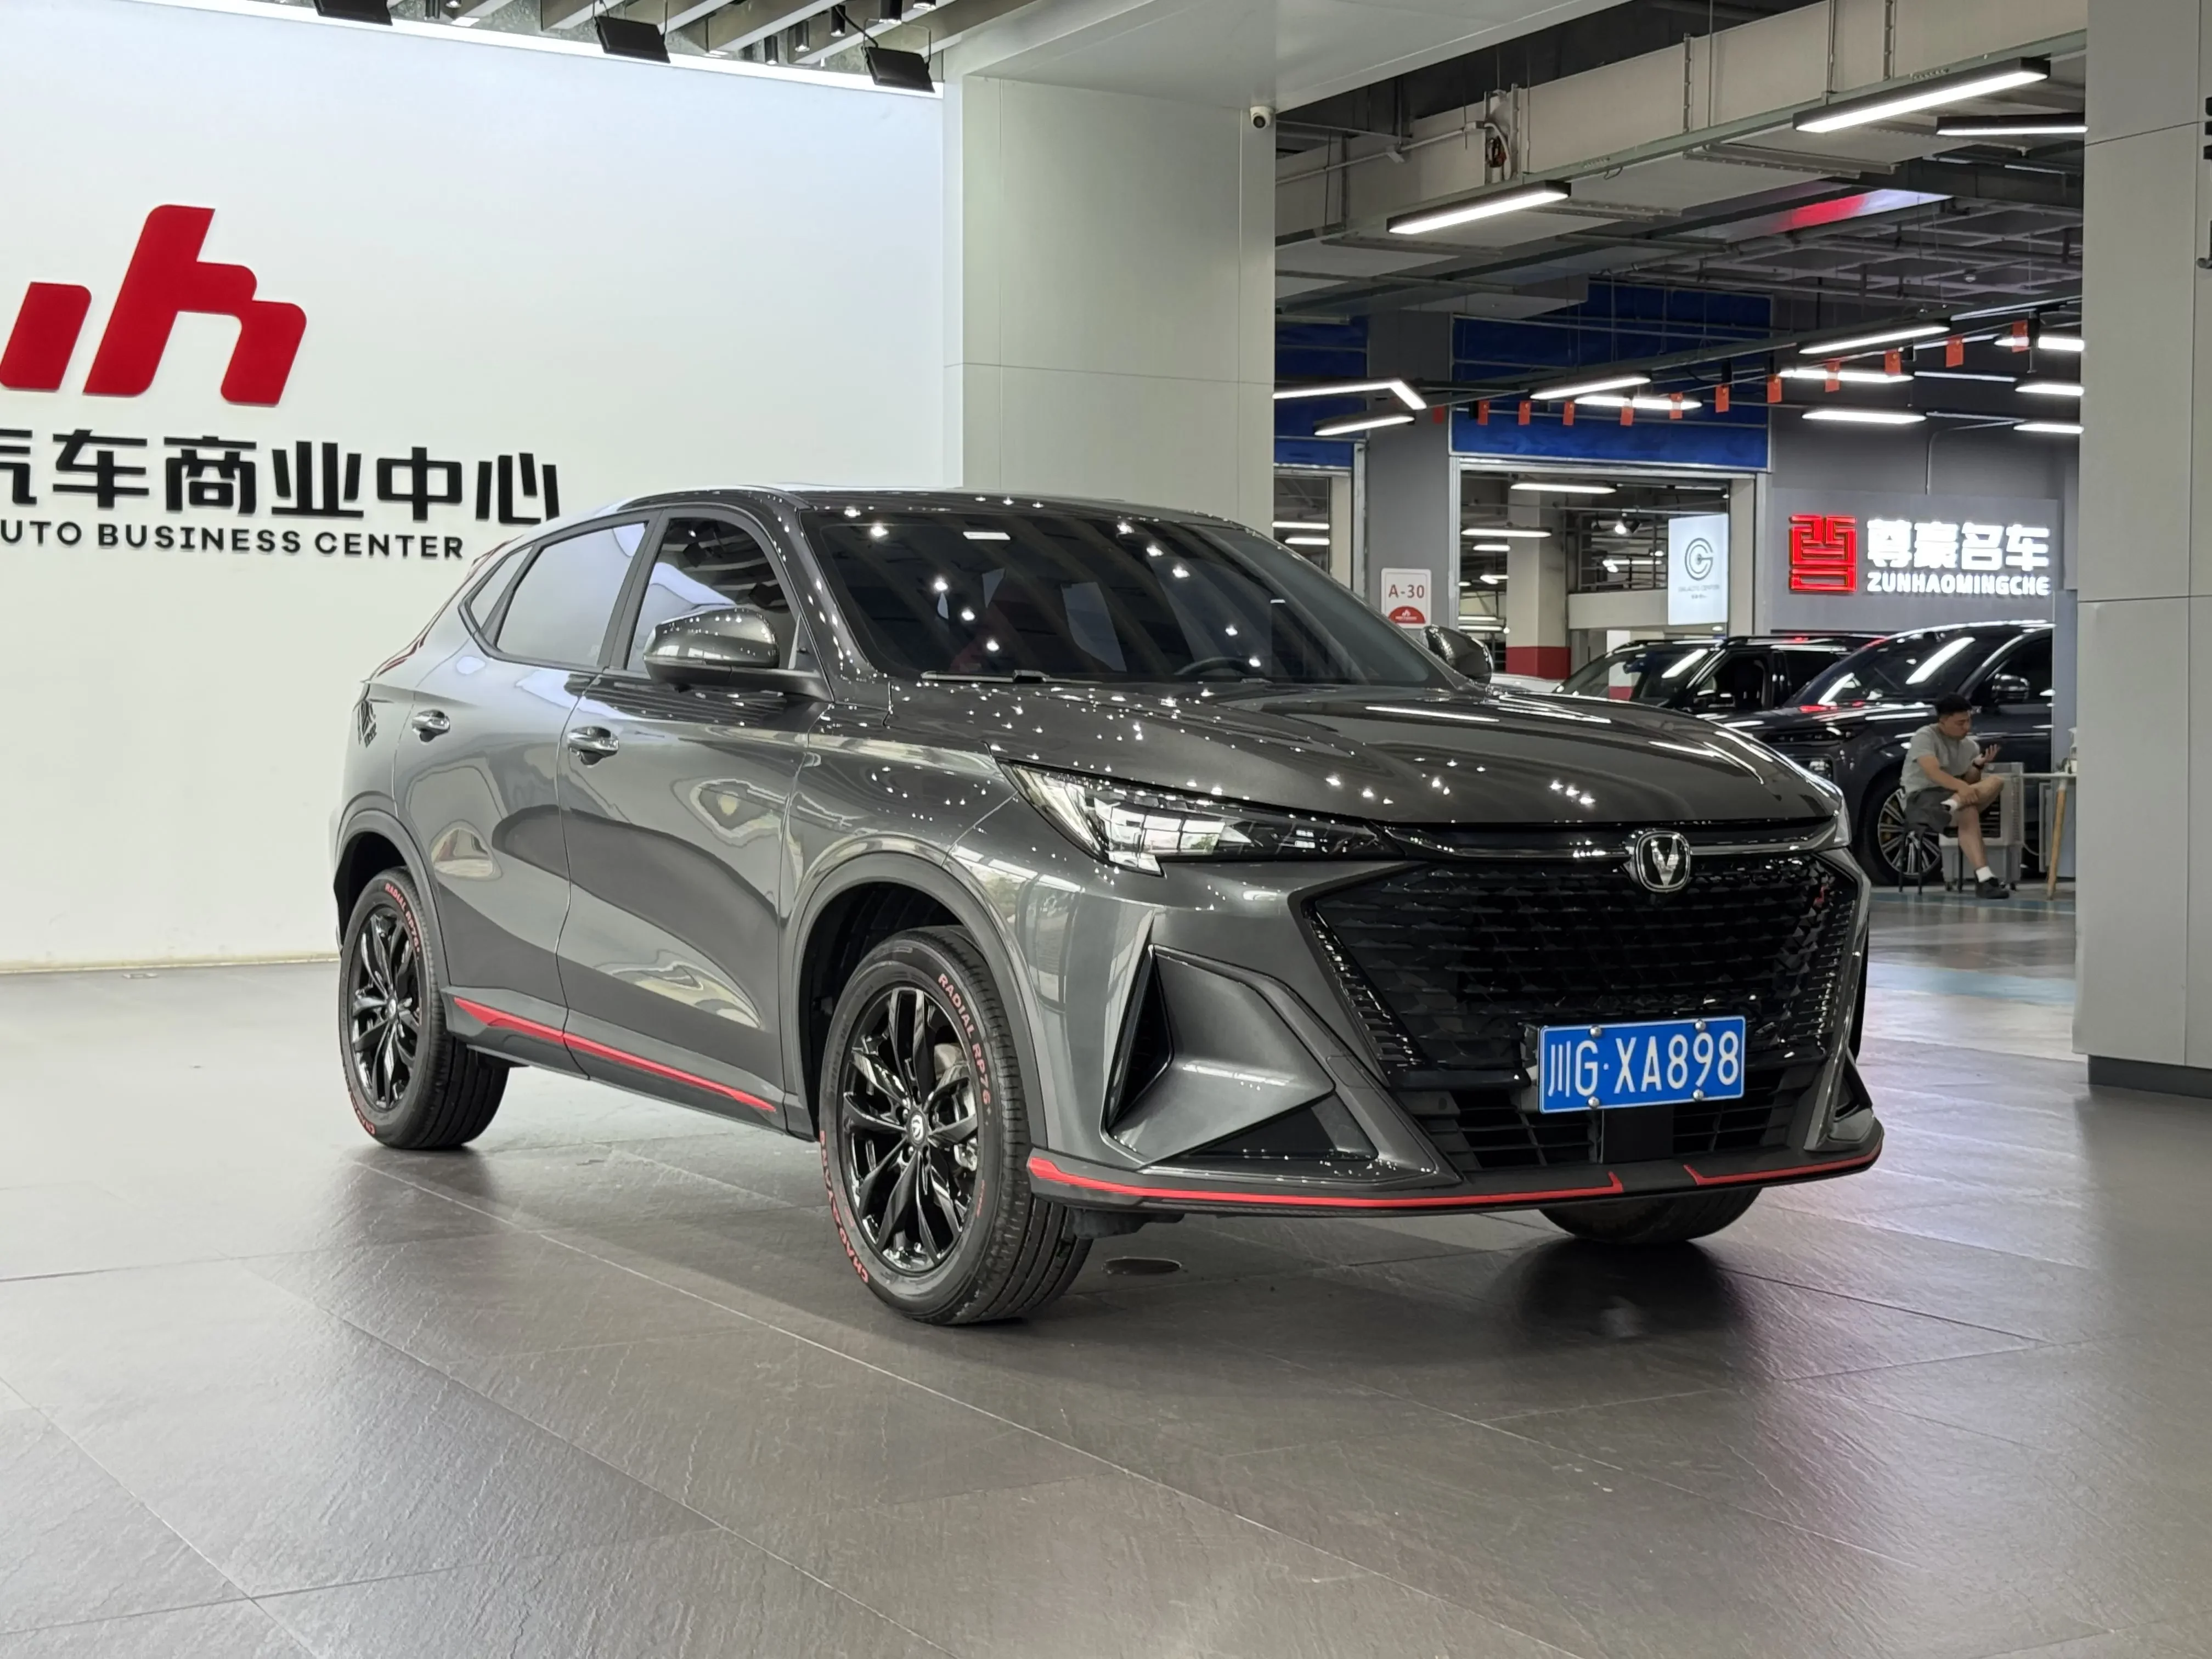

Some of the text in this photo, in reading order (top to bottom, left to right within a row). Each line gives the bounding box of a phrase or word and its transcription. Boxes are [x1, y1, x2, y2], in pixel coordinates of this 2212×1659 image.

[98, 523, 301, 554] BUSINESS
[315, 531, 464, 558] CENTER
[1866, 519, 2050, 572] 尊豪名车
[1388, 584, 1425, 599] A-30
[1866, 572, 2051, 596] ZUNHAOMINGCHE
[938, 973, 975, 1040] RADIAL
[1548, 1030, 1740, 1098] 川G·XA898
